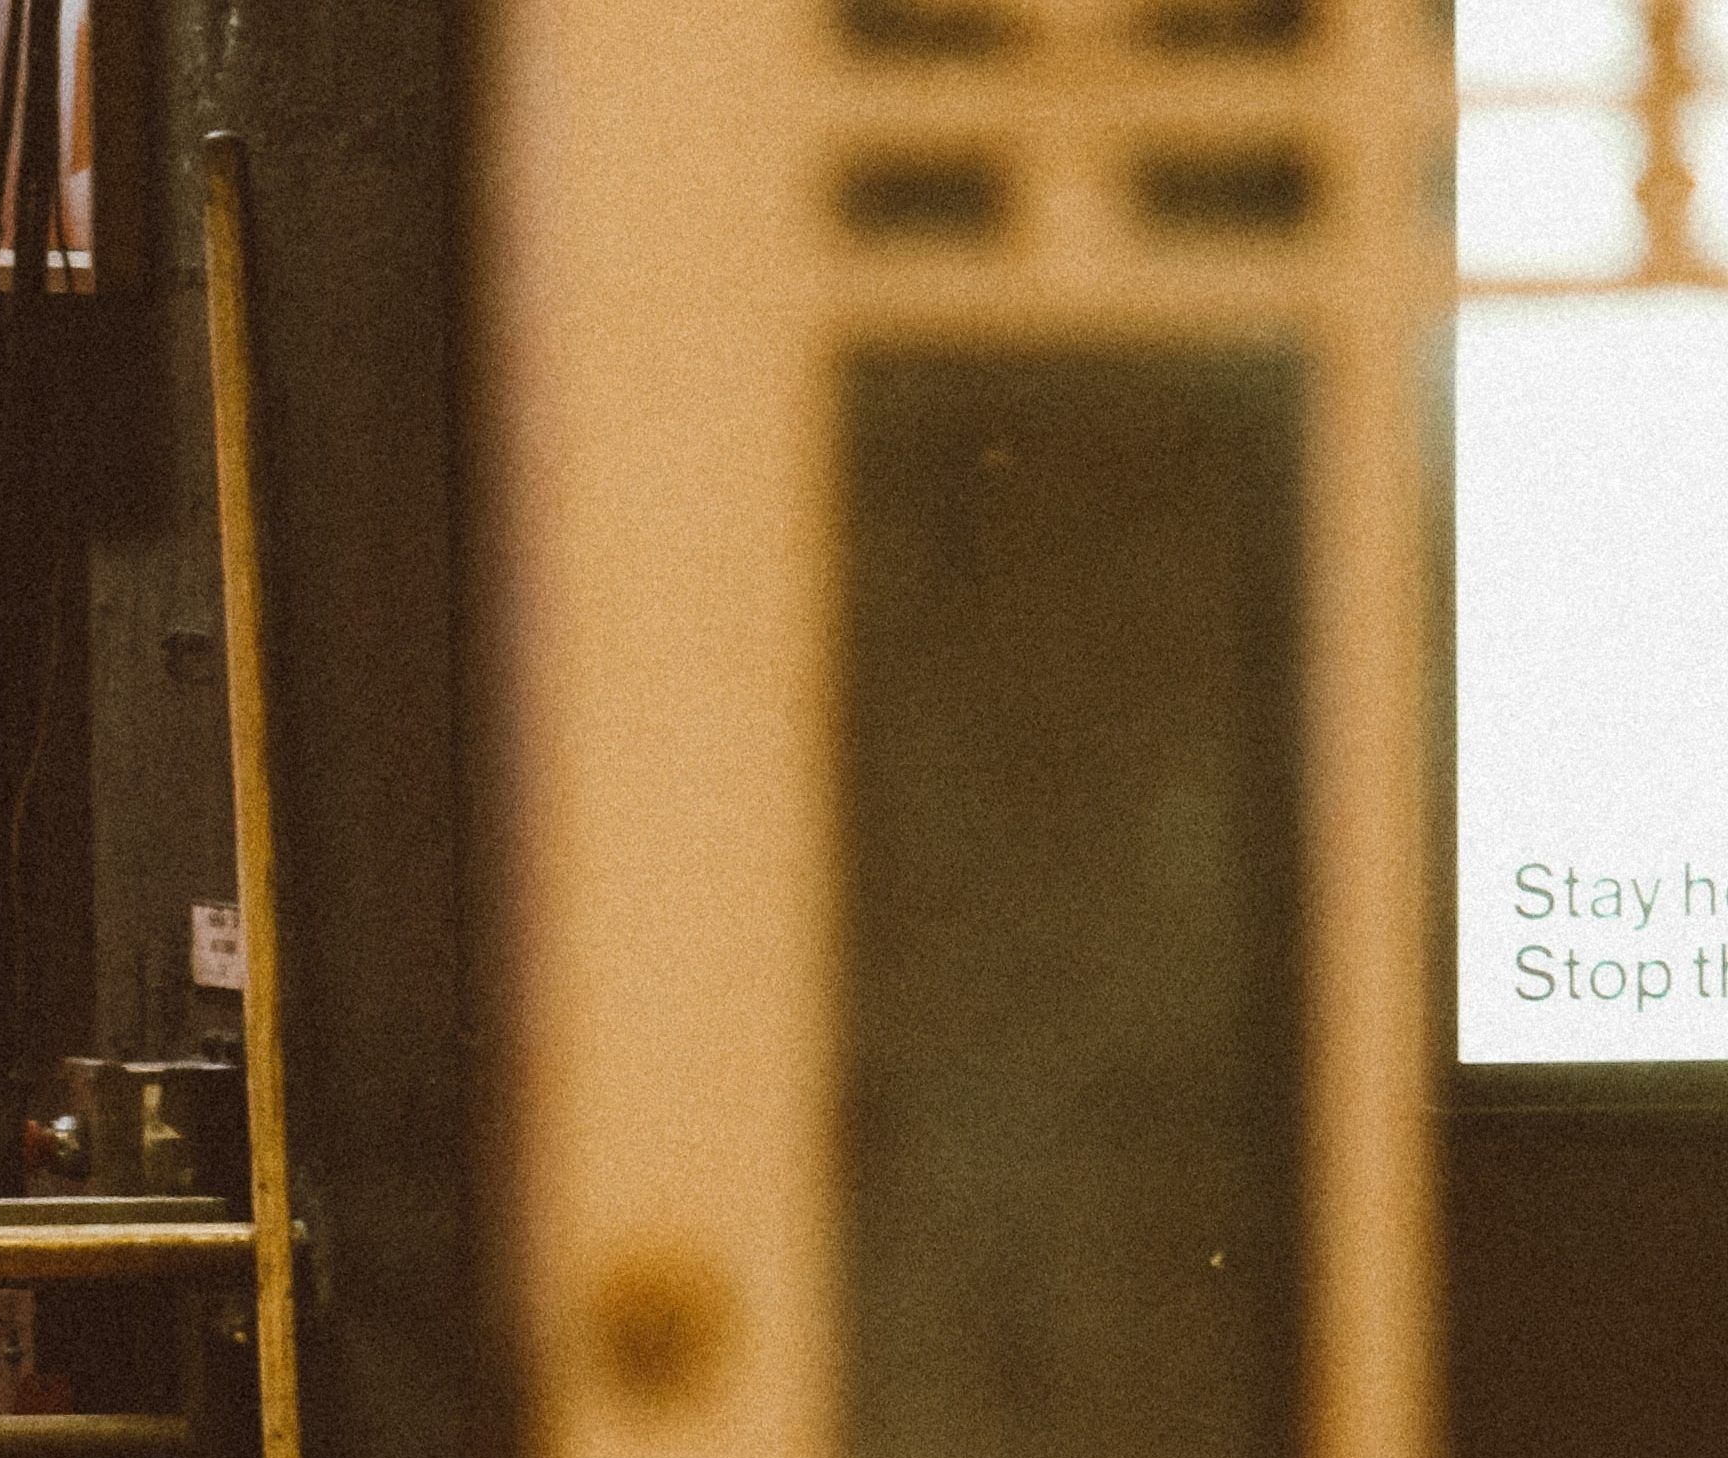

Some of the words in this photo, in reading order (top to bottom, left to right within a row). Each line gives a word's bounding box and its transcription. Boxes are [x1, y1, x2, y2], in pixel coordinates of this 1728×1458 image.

[1513, 862, 1662, 931] Stay
[1683, 861, 1728, 917] h
[1514, 943, 1673, 1013] Stop
